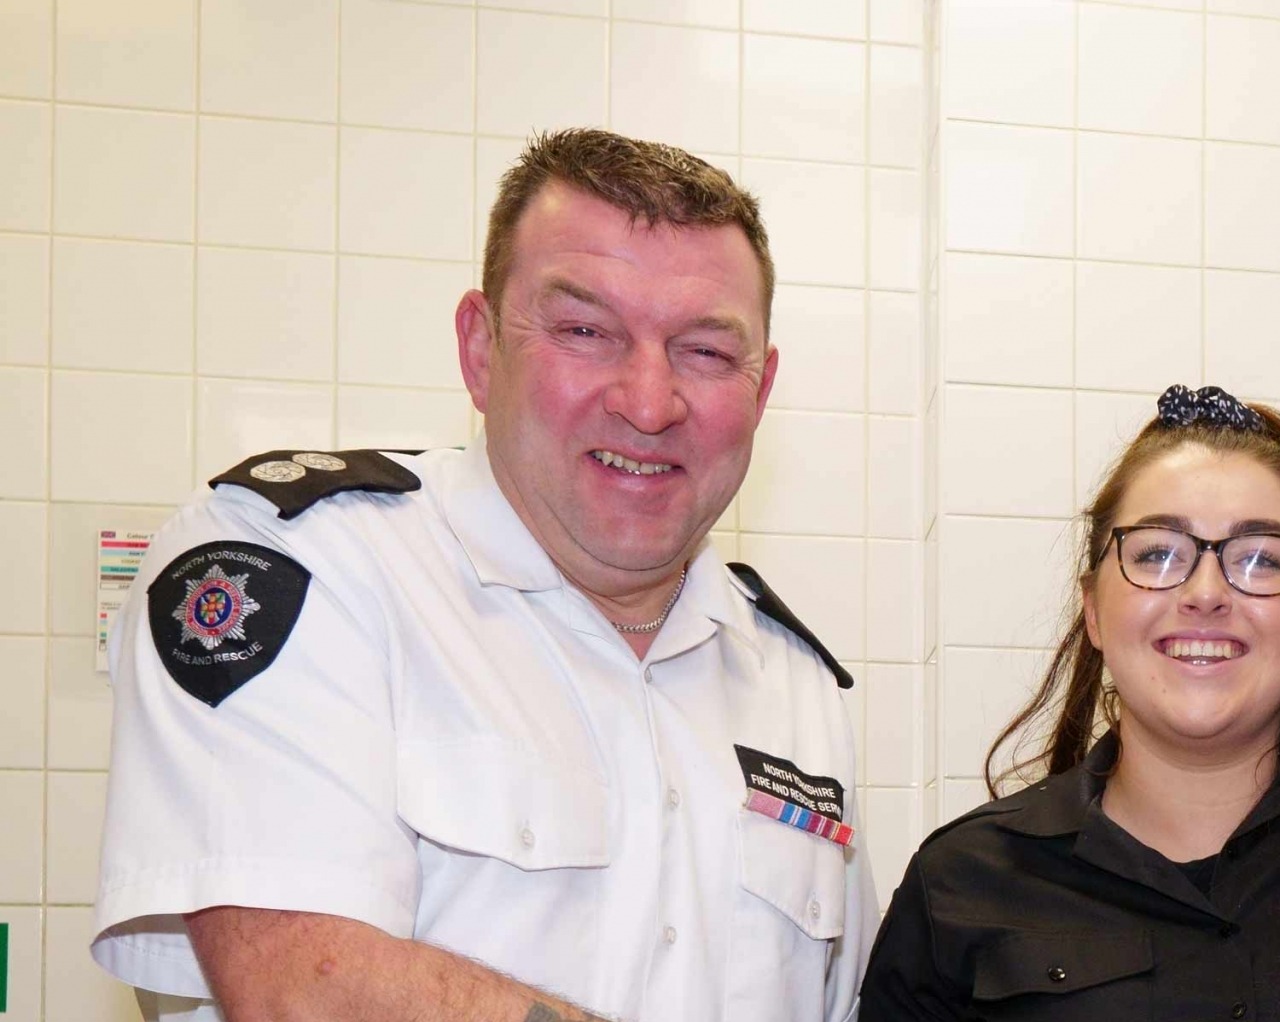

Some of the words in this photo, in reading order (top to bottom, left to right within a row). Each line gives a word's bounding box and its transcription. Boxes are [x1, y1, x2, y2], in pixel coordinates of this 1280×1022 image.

[172, 553, 206, 581] NORTH
[207, 550, 272, 572] YORKSHIRE
[172, 648, 190, 665] FIRE
[191, 655, 213, 666] AND
[213, 641, 264, 664] RESCUE
[750, 773, 772, 790] FIRE
[771, 781, 790, 797] AND
[790, 787, 818, 812] RESCUE
[762, 762, 793, 783] NORTH
[792, 773, 837, 799] YORKSHIRE
